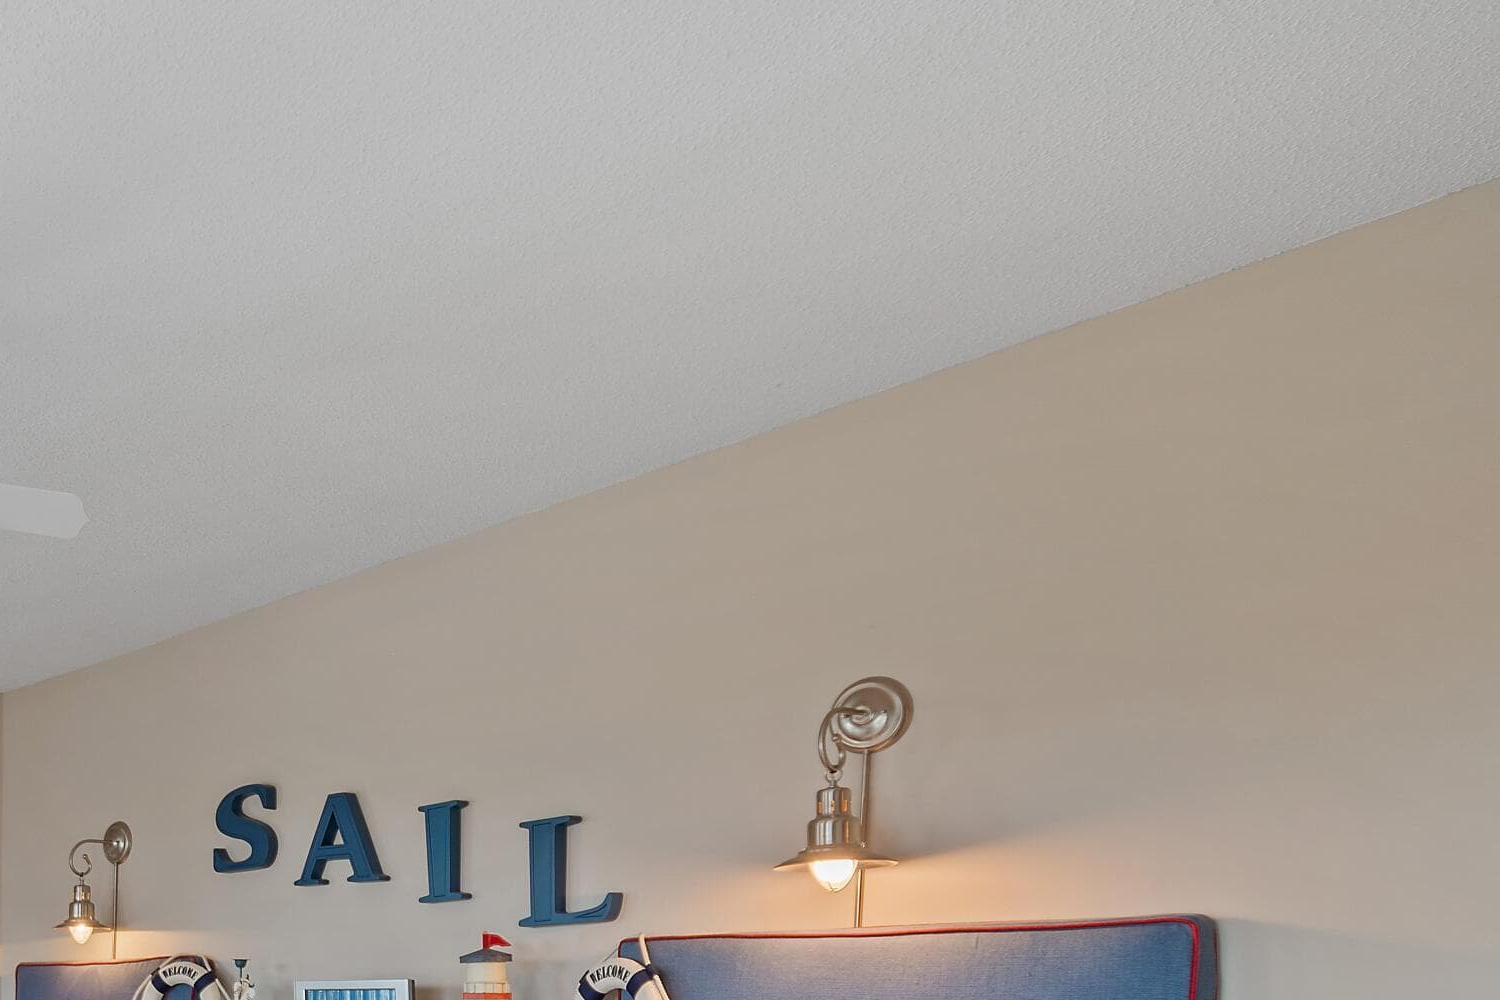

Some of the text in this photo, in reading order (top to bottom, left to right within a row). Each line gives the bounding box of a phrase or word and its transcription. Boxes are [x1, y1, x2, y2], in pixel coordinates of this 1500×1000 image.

[212, 783, 624, 928] SAIL
[162, 965, 199, 981] WELCOME
[589, 964, 631, 984] WELCOME
